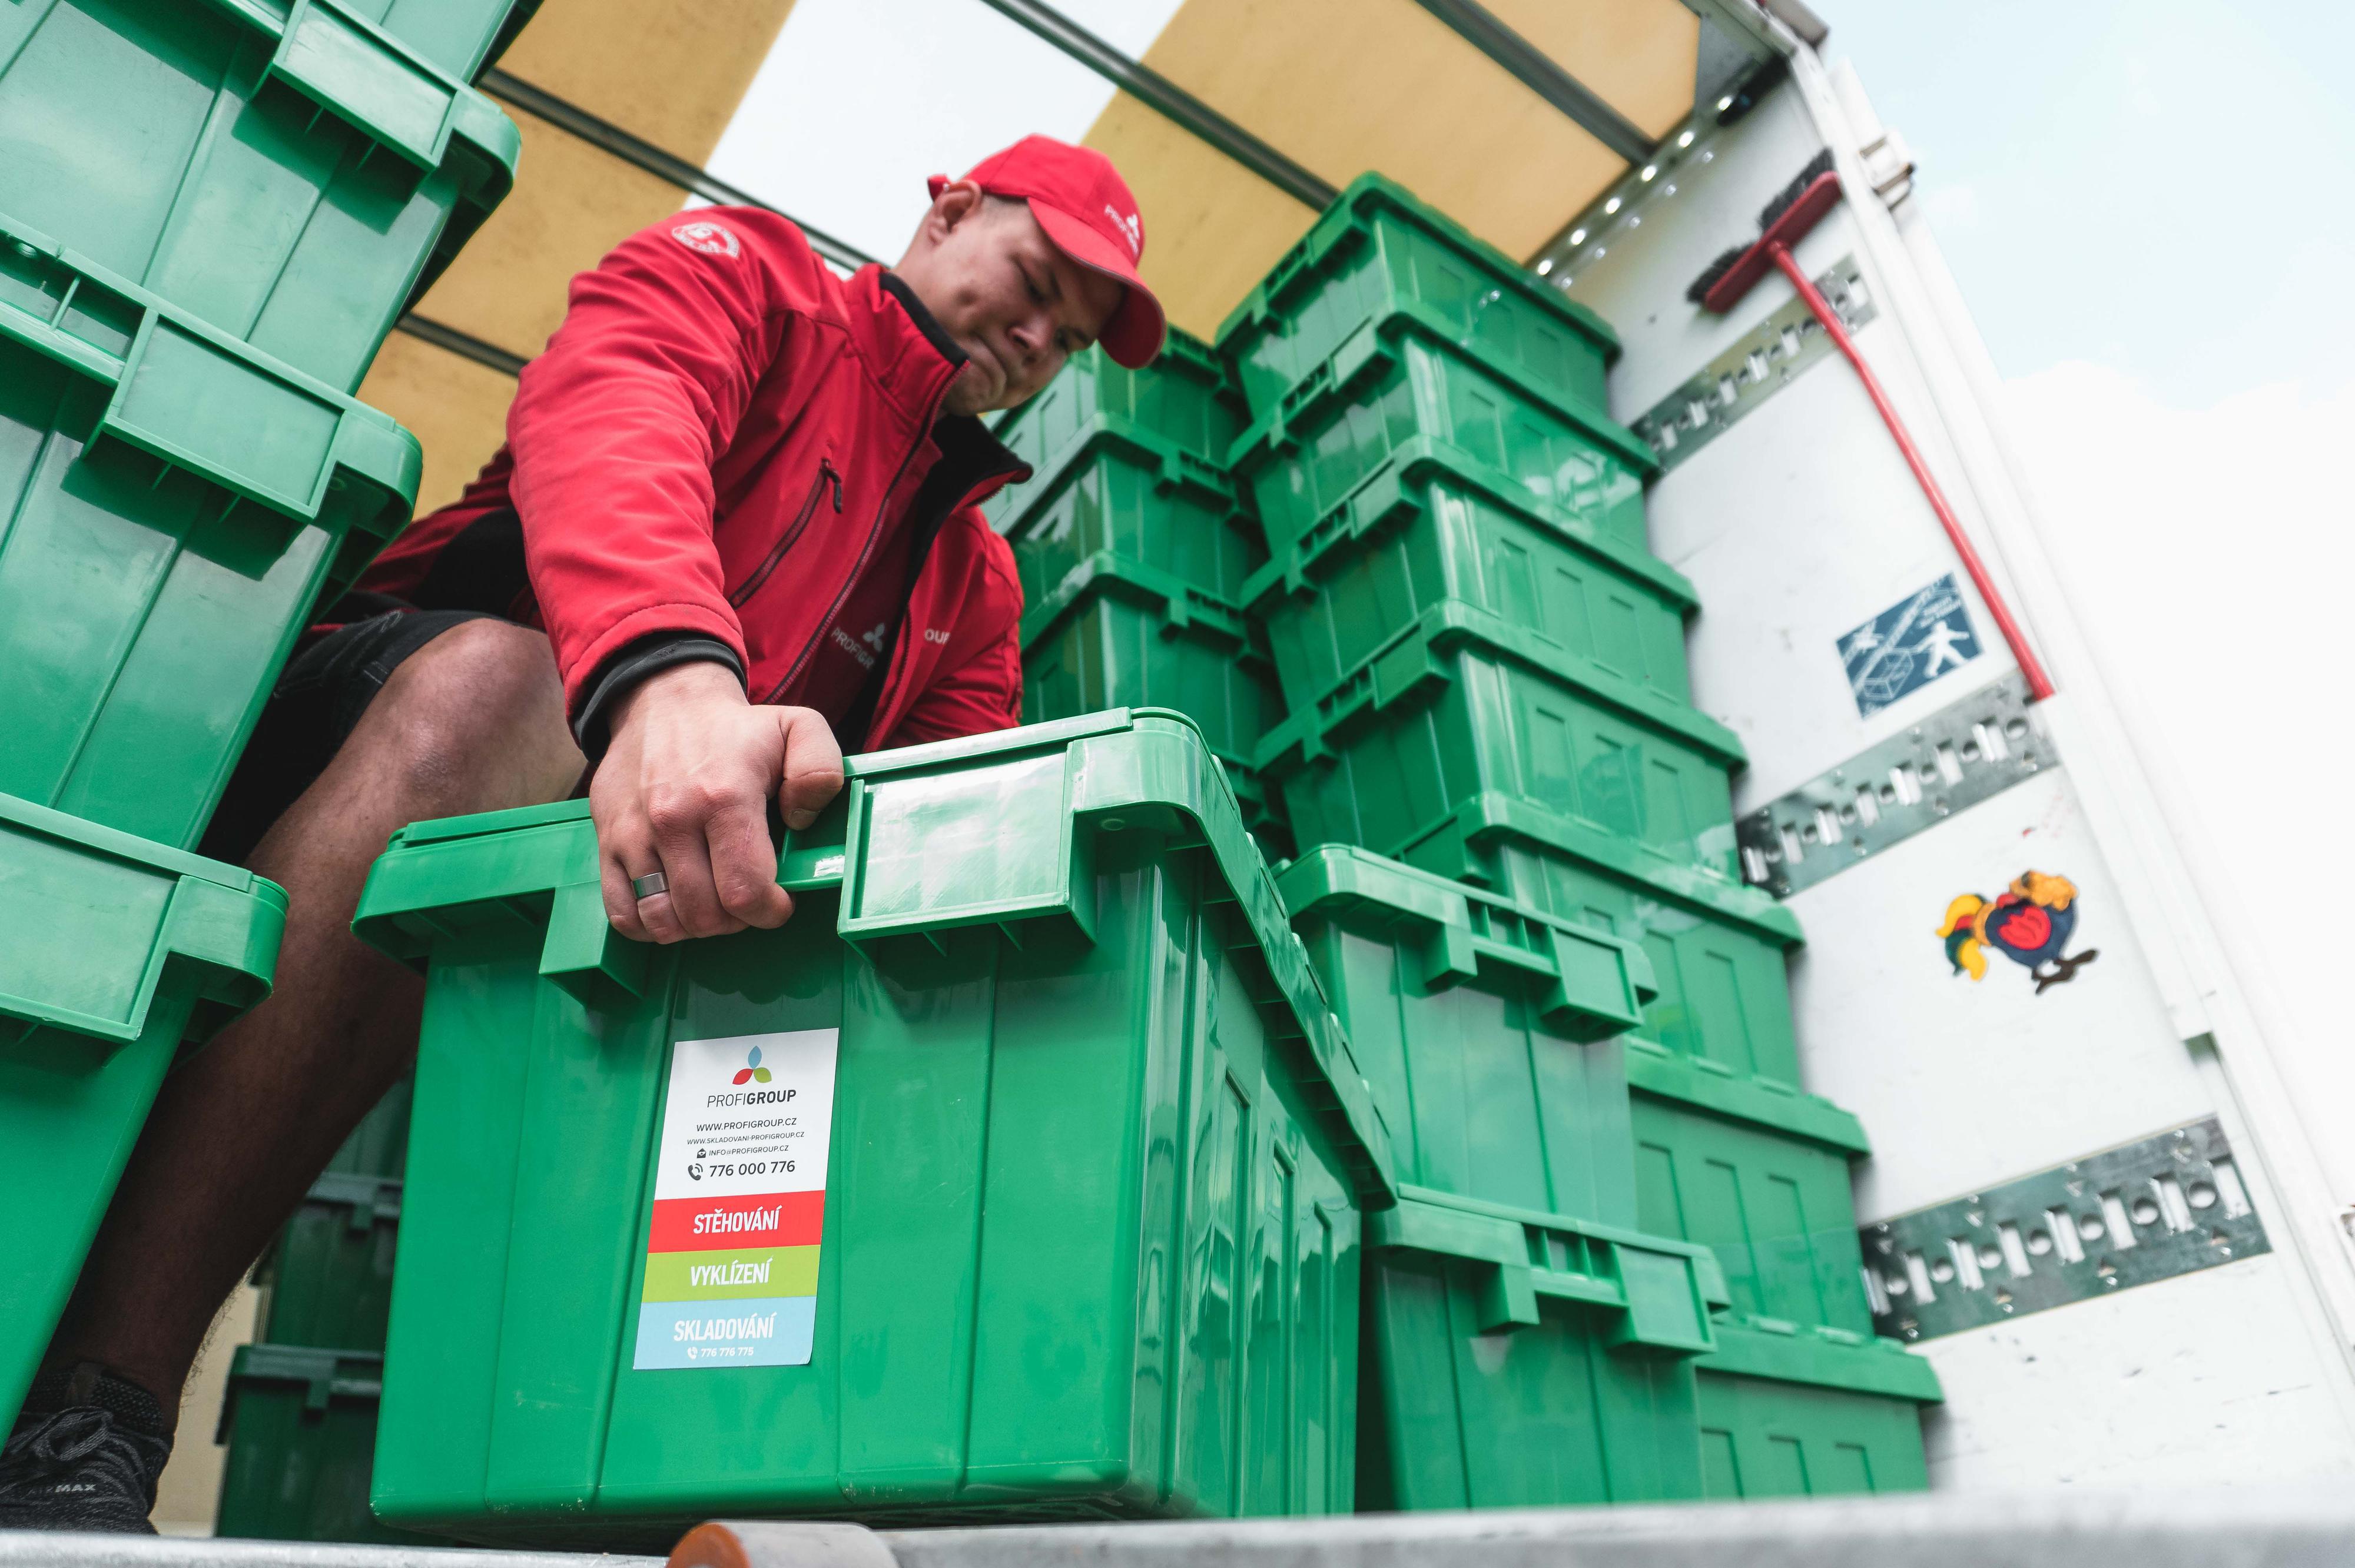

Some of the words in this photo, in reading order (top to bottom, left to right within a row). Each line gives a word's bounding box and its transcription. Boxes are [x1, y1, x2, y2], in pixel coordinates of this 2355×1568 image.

[707, 1089, 797, 1108] PROFIGROUP
[696, 1117, 797, 1132] WWW.PROFIGROUP.CZ
[687, 1131, 805, 1145] WWW.SKLADOVANI-PROFIGROUP.CZ
[709, 1145, 789, 1156] INFO@PROFIGROUP.CZ
[709, 1164, 734, 1177] 776
[738, 1162, 766, 1175] 000
[770, 1160, 795, 1174] 776
[693, 1205, 782, 1234] STĚHOVÁNÍ
[691, 1255, 773, 1287] VYKLÍZENÍ
[673, 1311, 778, 1342] SKLADOVÁNÍ
[701, 1347, 717, 1358] 776
[719, 1347, 735, 1357] 776
[738, 1346, 754, 1356] 775
[55, 1483, 96, 1493] MAX
